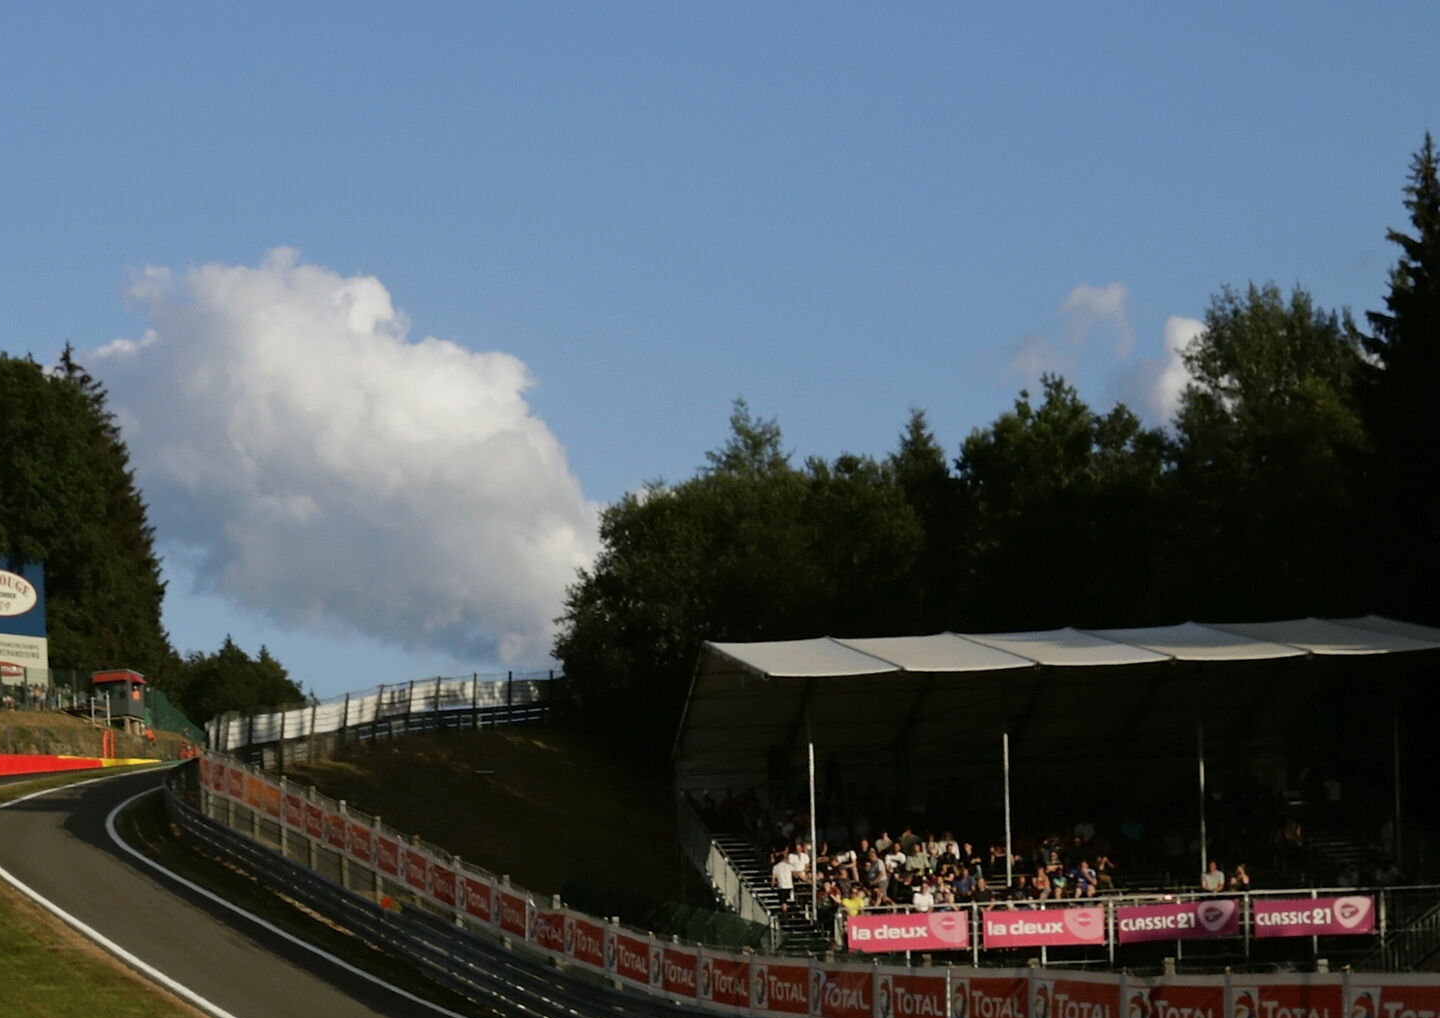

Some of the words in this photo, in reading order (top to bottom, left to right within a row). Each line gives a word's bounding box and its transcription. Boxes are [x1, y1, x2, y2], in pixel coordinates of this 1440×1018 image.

[987, 920, 1007, 936] la
[1010, 920, 1064, 935] deux
[1120, 915, 1175, 932] CLASSIC
[1176, 912, 1196, 929] 21
[1256, 910, 1311, 927] CLASSIC
[1312, 907, 1332, 925] 21
[576, 929, 603, 958] TOTAL
[852, 925, 871, 941] la
[873, 924, 928, 940] deux
[618, 944, 648, 975] TOTAL
[663, 959, 696, 988] TOTAL
[713, 969, 748, 997] TOTAL
[768, 976, 807, 1003] TOTAL
[824, 982, 871, 1011] TOTAL
[894, 987, 944, 1018] TOTAL
